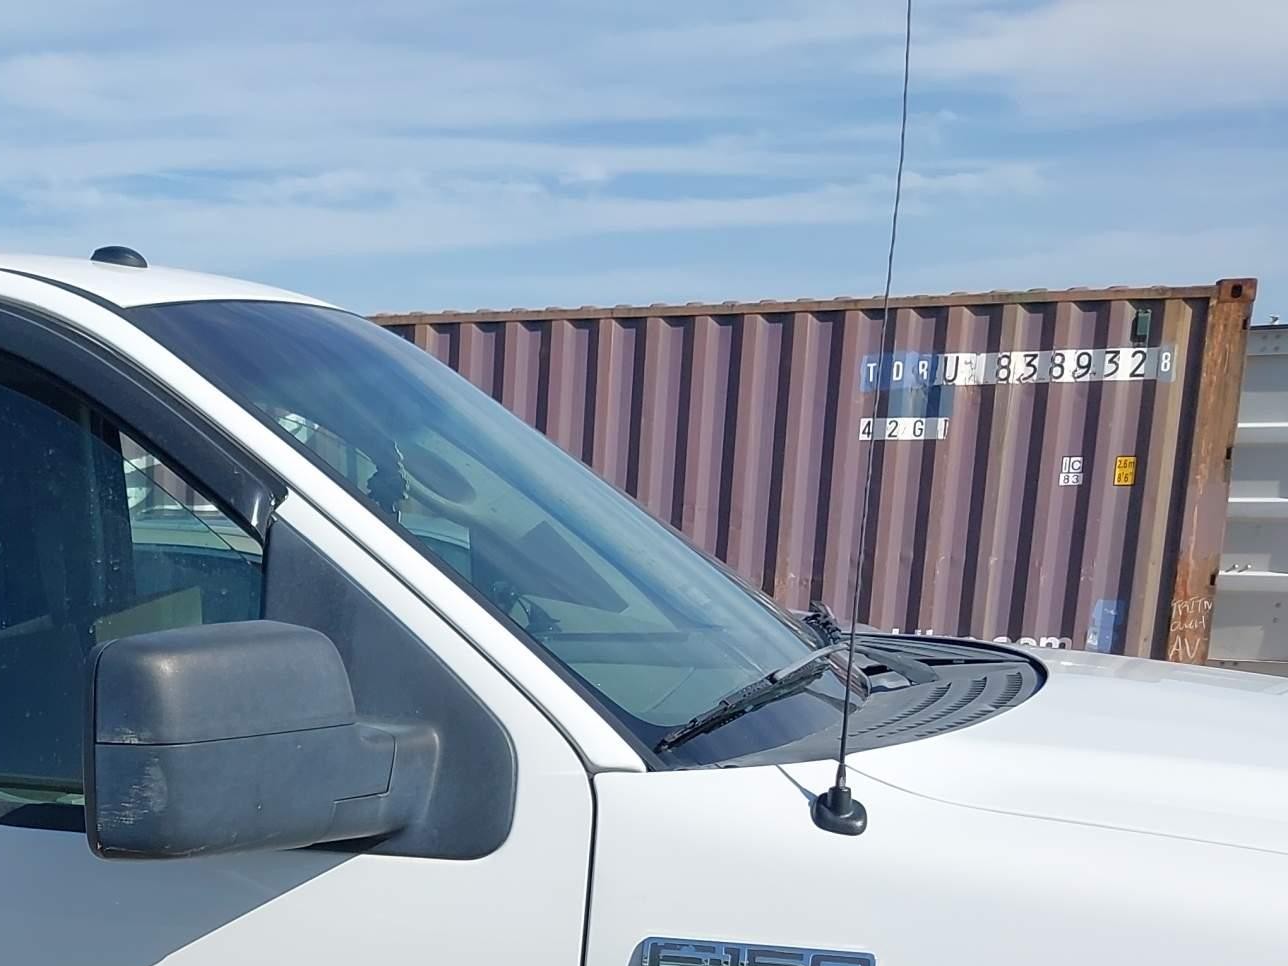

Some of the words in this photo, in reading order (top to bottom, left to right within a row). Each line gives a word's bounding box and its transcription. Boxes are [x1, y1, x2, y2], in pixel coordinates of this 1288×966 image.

[996, 350, 1147, 382] 838932
[1160, 352, 1172, 371] 8
[1063, 474, 1080, 484] 83
